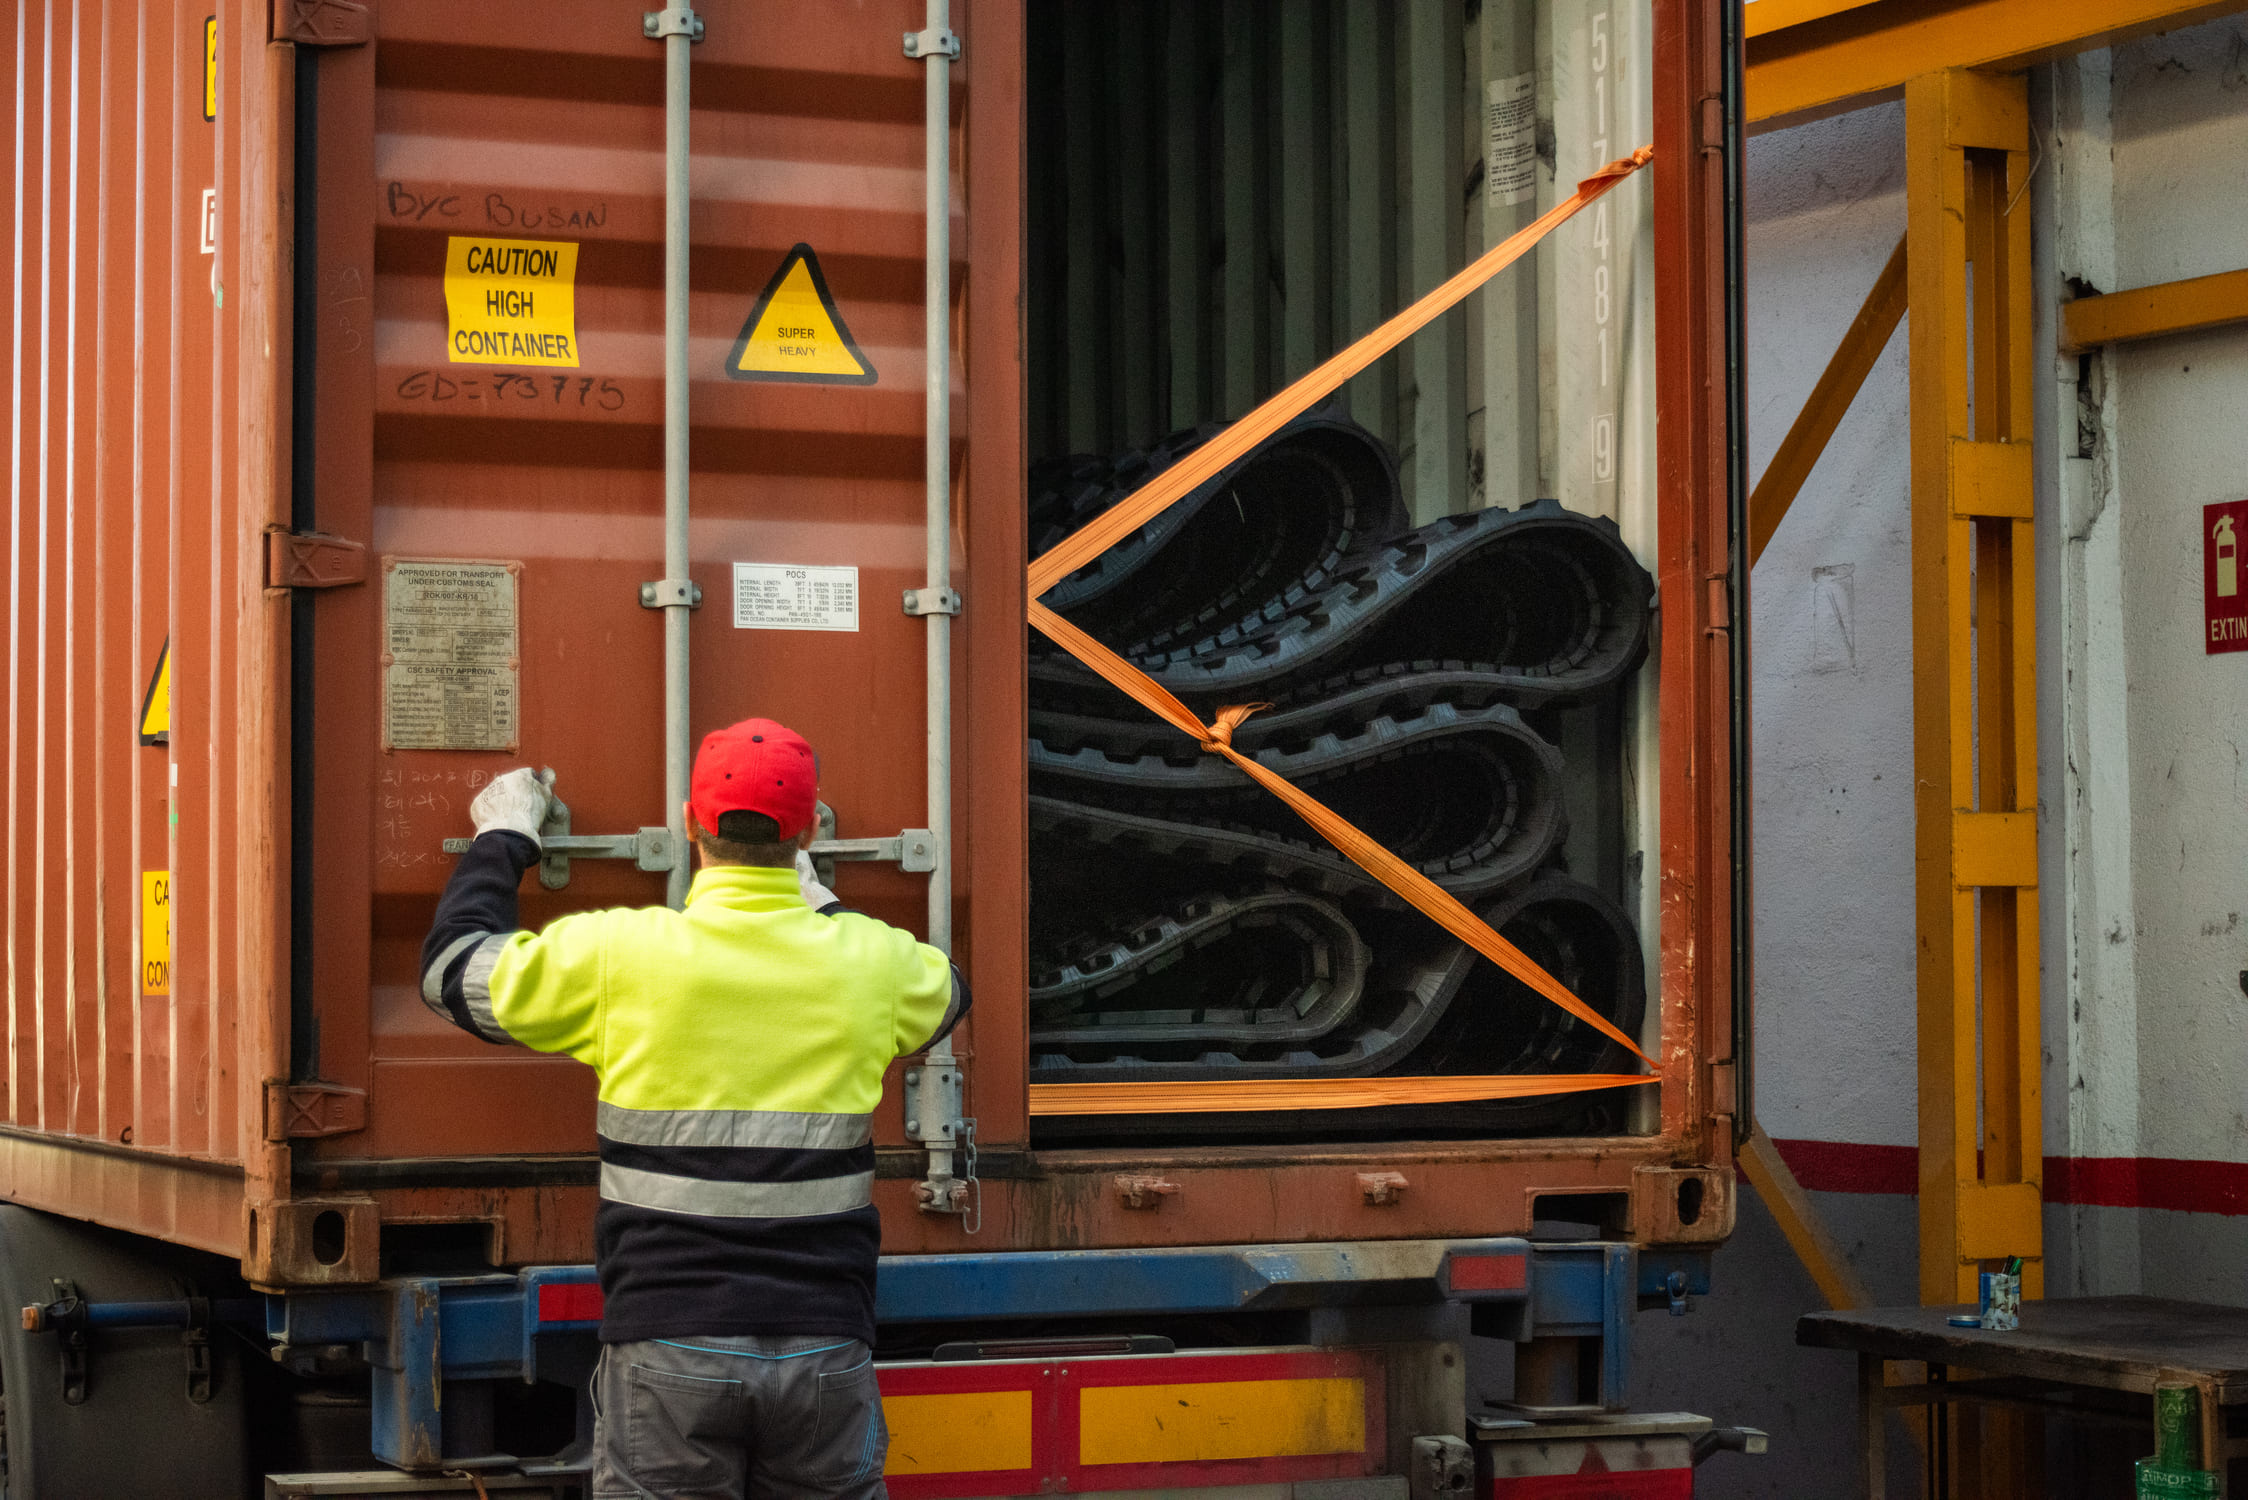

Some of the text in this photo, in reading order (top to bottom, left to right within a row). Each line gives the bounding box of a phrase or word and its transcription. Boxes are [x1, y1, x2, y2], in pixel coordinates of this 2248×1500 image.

[467, 246, 558, 277] CAUTION
[486, 289, 534, 318] HIGH
[777, 327, 815, 339] SUPER
[455, 329, 571, 359] CONTAINER
[779, 346, 816, 357] HEAVY
[398, 569, 505, 579] APPROVED FOR TRANSPORT
[786, 570, 807, 579] POCS
[408, 578, 435, 586] UNDER
[436, 579, 474, 587] CUSTOMS
[2211, 616, 2248, 641] EXTIN
[493, 689, 510, 697] ACEP
